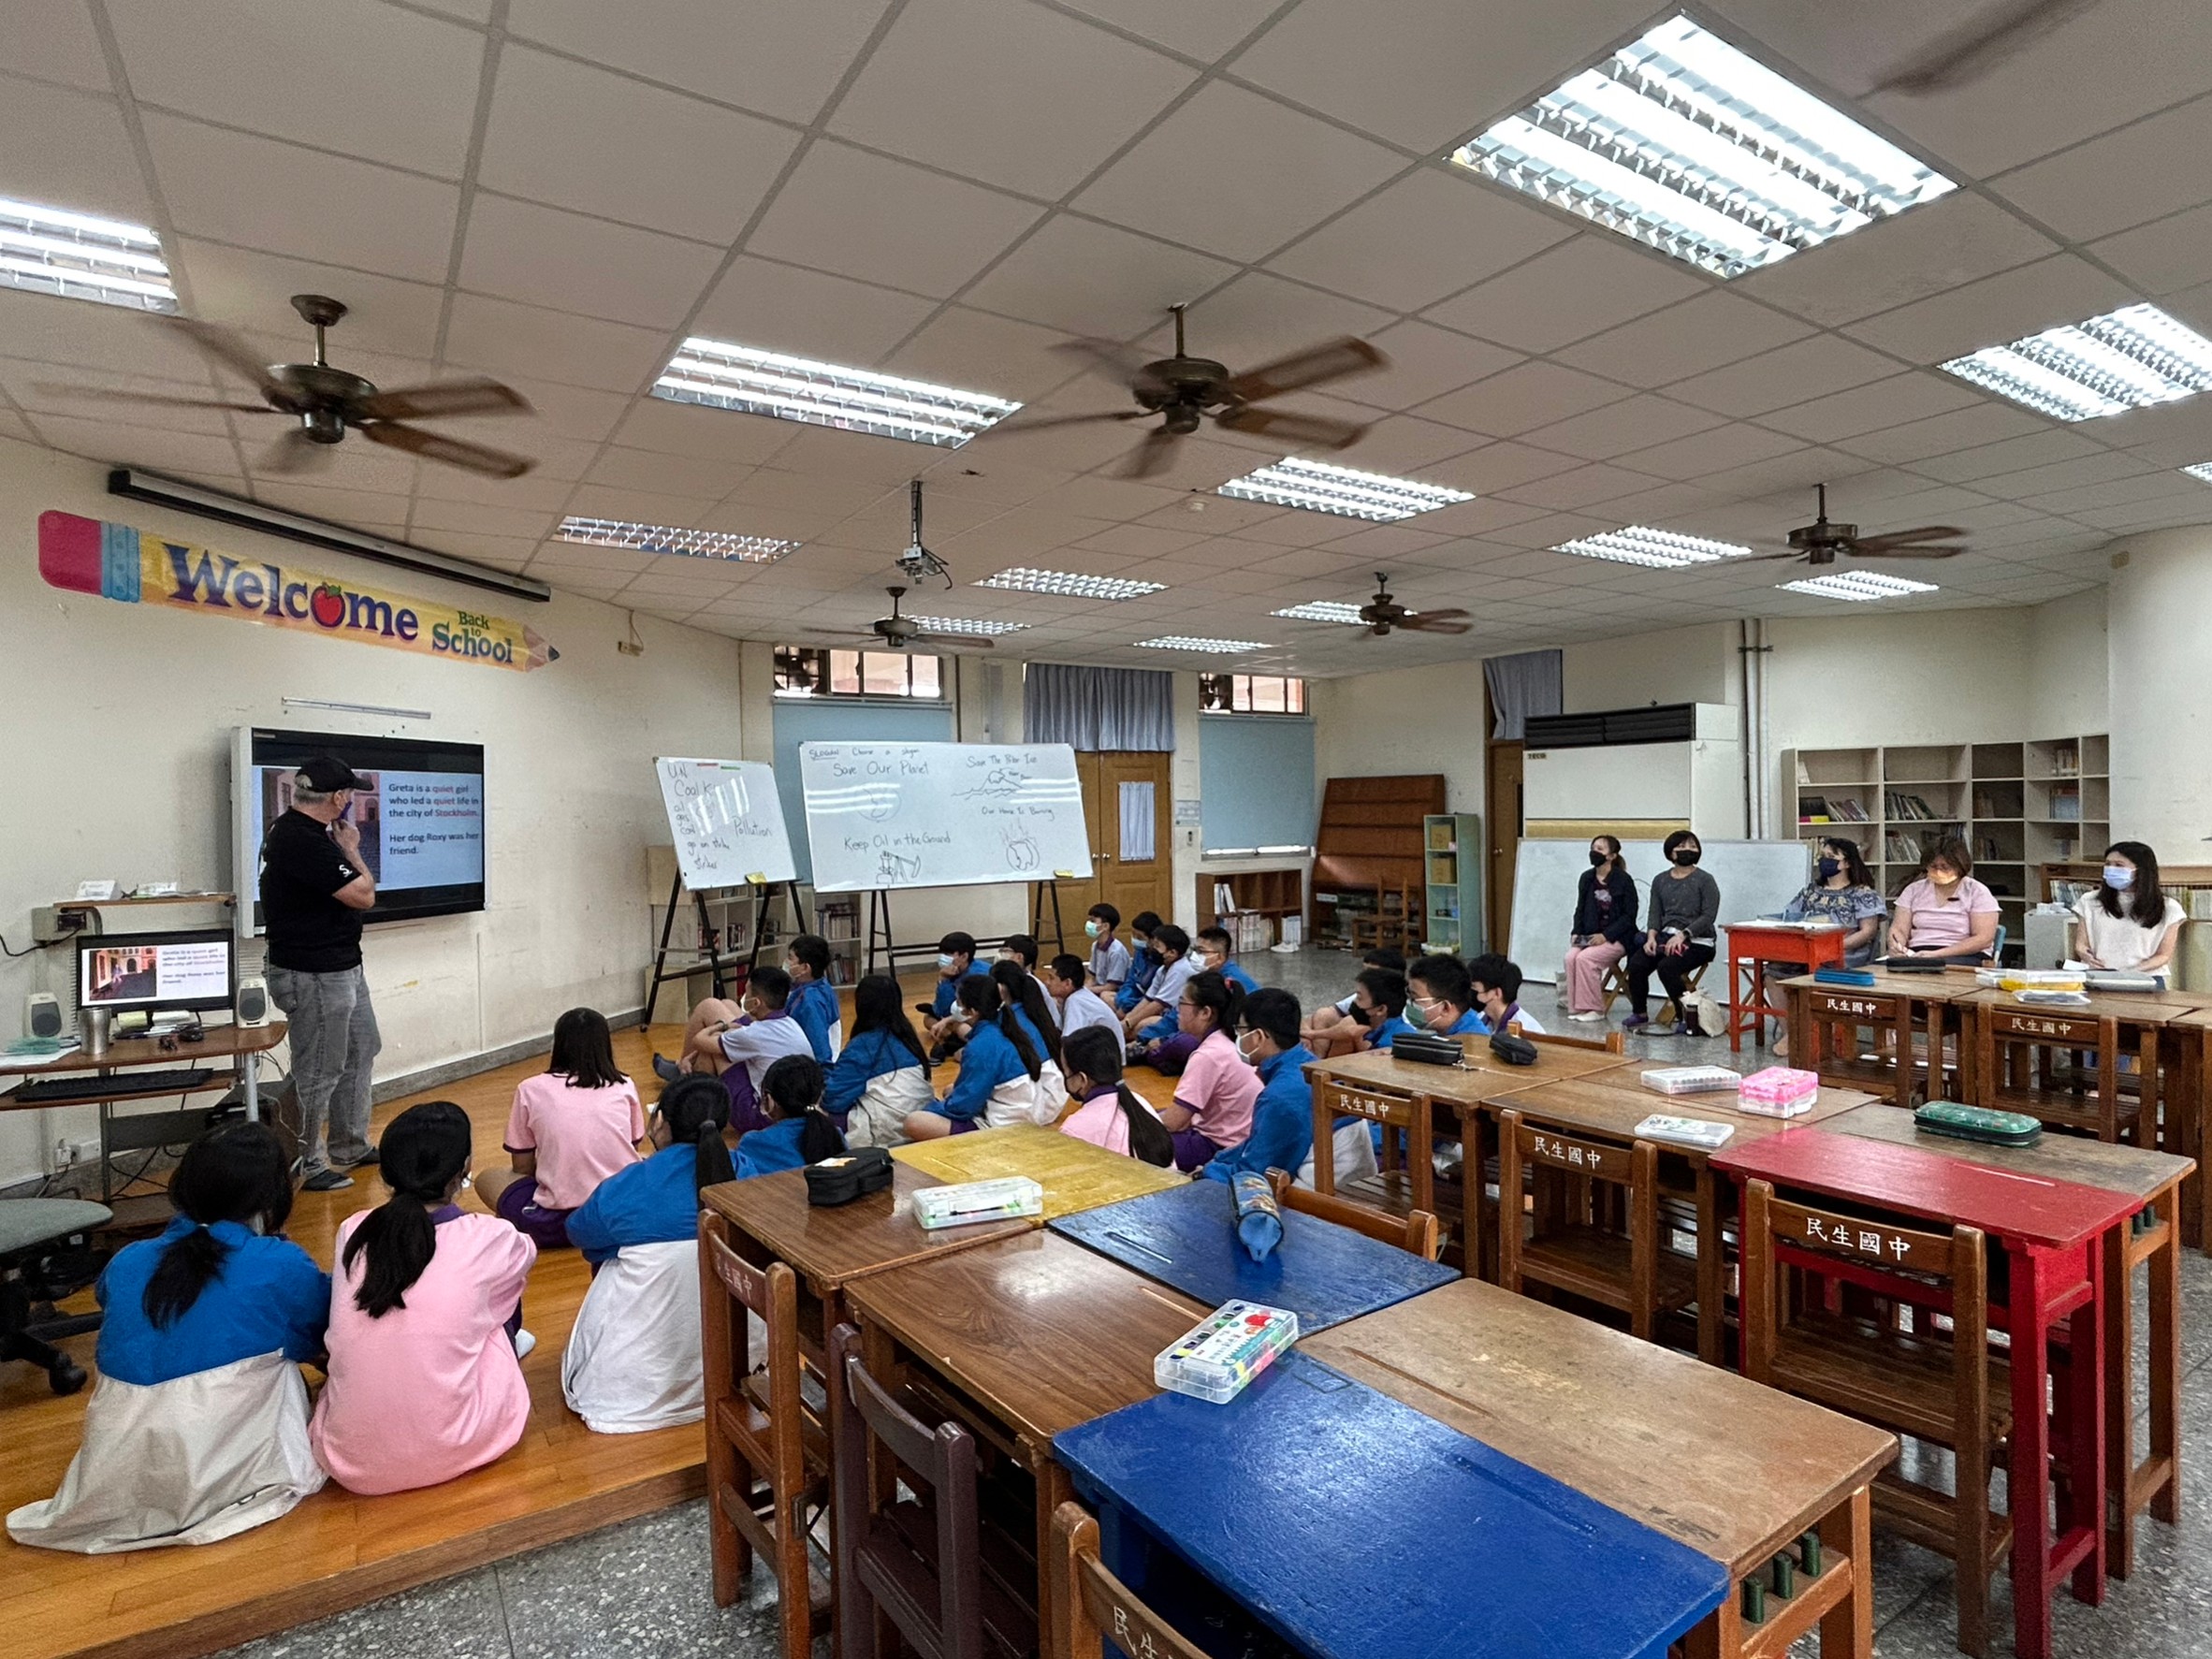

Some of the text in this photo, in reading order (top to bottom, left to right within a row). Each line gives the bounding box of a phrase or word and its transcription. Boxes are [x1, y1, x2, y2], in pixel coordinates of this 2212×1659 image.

[162, 542, 419, 641] Welcome
[457, 610, 489, 630] Back
[432, 621, 513, 663] School
[471, 627, 482, 637] to
[833, 763, 858, 778] Save
[866, 761, 892, 776] Our
[388, 783, 414, 793] Greta
[415, 784, 424, 793] is
[432, 785, 454, 794] quiet
[455, 785, 469, 794] girl
[674, 779, 700, 797] Coal
[388, 796, 409, 805] who
[411, 796, 425, 805] led
[433, 797, 455, 807] quiet
[457, 796, 470, 805] life
[471, 796, 479, 805] in
[388, 808, 479, 819] the city of Stockholm.
[732, 815, 773, 837] Pollution
[389, 834, 406, 842] Her
[407, 833, 425, 843] dog
[426, 833, 447, 842] Roxy
[465, 832, 479, 840] her
[844, 837, 869, 853] Keep
[872, 835, 889, 848] Oil
[904, 833, 922, 845] the
[922, 831, 951, 844] Ground
[389, 846, 419, 855] friend.
[1826, 997, 1877, 1015] 民生國中
[2011, 1016, 2073, 1036] 民生國中
[1340, 1093, 1390, 1118] 民生國中
[1535, 1135, 1602, 1170] 民生國中
[1806, 1216, 1911, 1261] 民生國中
[1113, 1605, 1173, 1659] 民生
